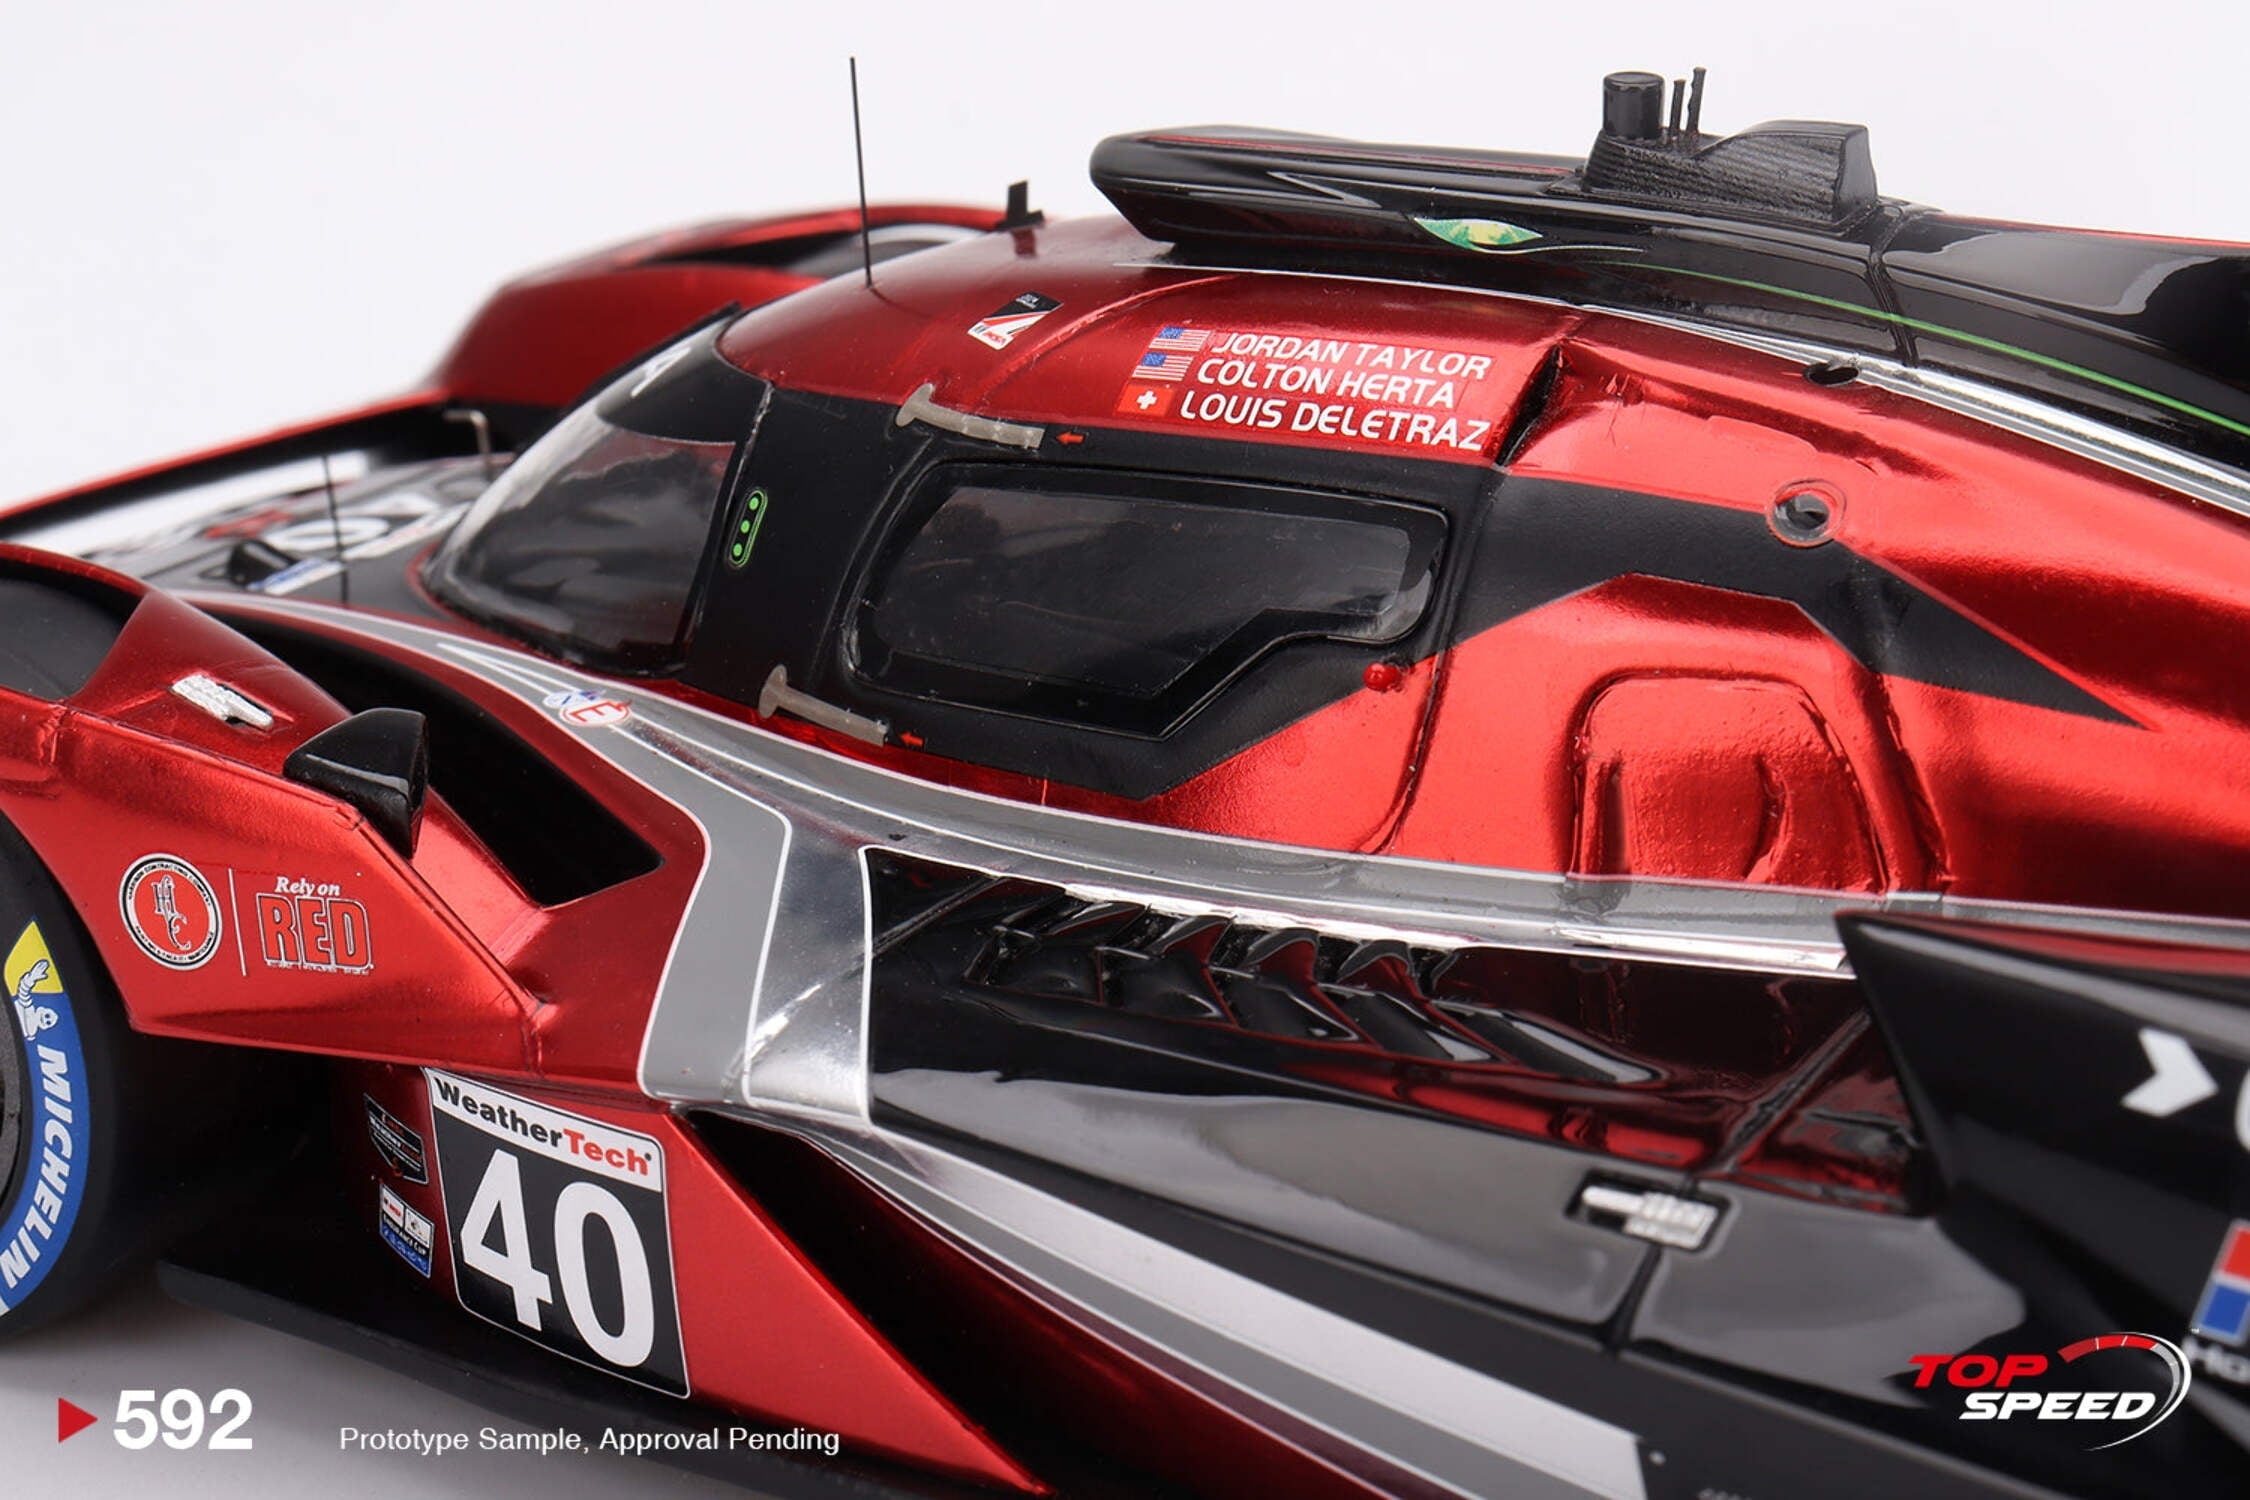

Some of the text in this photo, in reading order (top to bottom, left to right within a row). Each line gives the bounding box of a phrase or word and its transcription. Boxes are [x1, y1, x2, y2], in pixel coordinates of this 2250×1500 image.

[1197, 358, 1456, 408] COLTON HERTA
[1211, 333, 1492, 379] JORDAN TAYLOR
[1180, 391, 1491, 450] LOUIS DELETRAZ
[275, 876, 341, 897] Rely on
[256, 892, 372, 970] RED
[433, 1076, 651, 1176] WeatherTech
[1, 1044, 73, 1289] MICHELIN
[460, 1148, 654, 1367] 40
